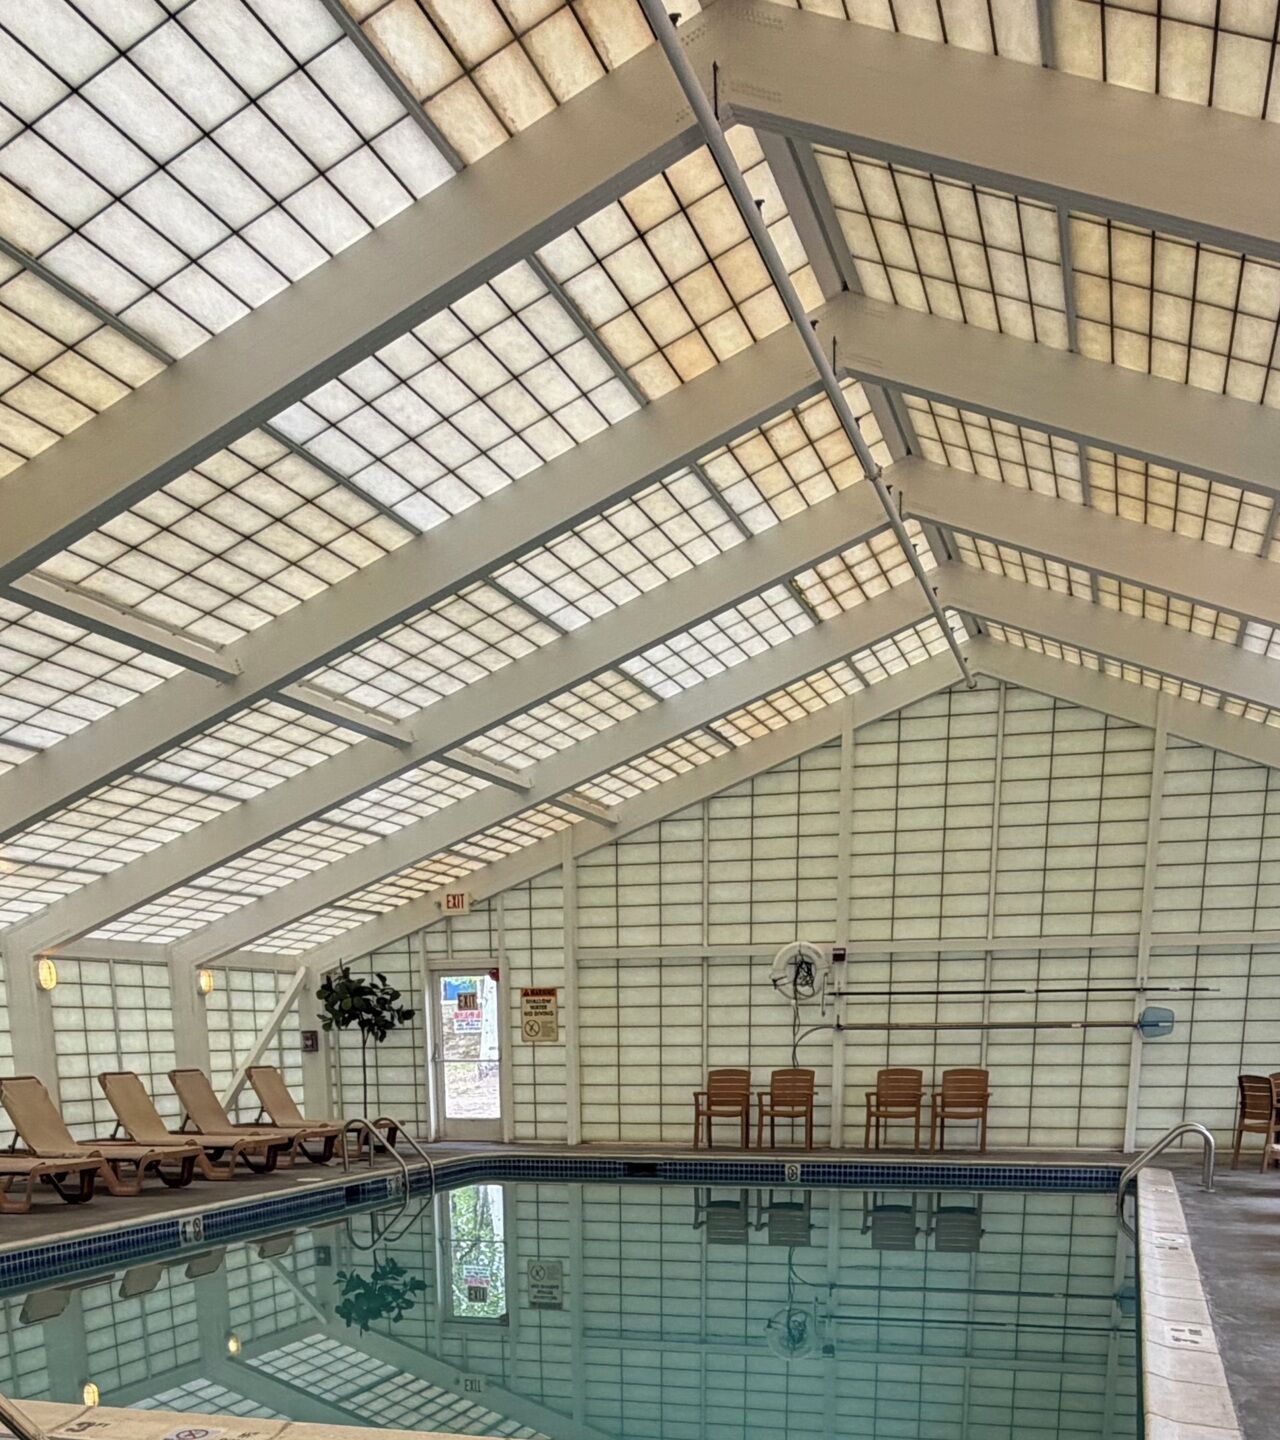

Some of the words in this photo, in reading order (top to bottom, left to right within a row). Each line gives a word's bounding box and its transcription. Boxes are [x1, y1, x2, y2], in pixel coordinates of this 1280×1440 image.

[446, 893, 464, 909] EXIT
[458, 994, 477, 1009] EXIT
[64, 1421, 96, 1433] 3
